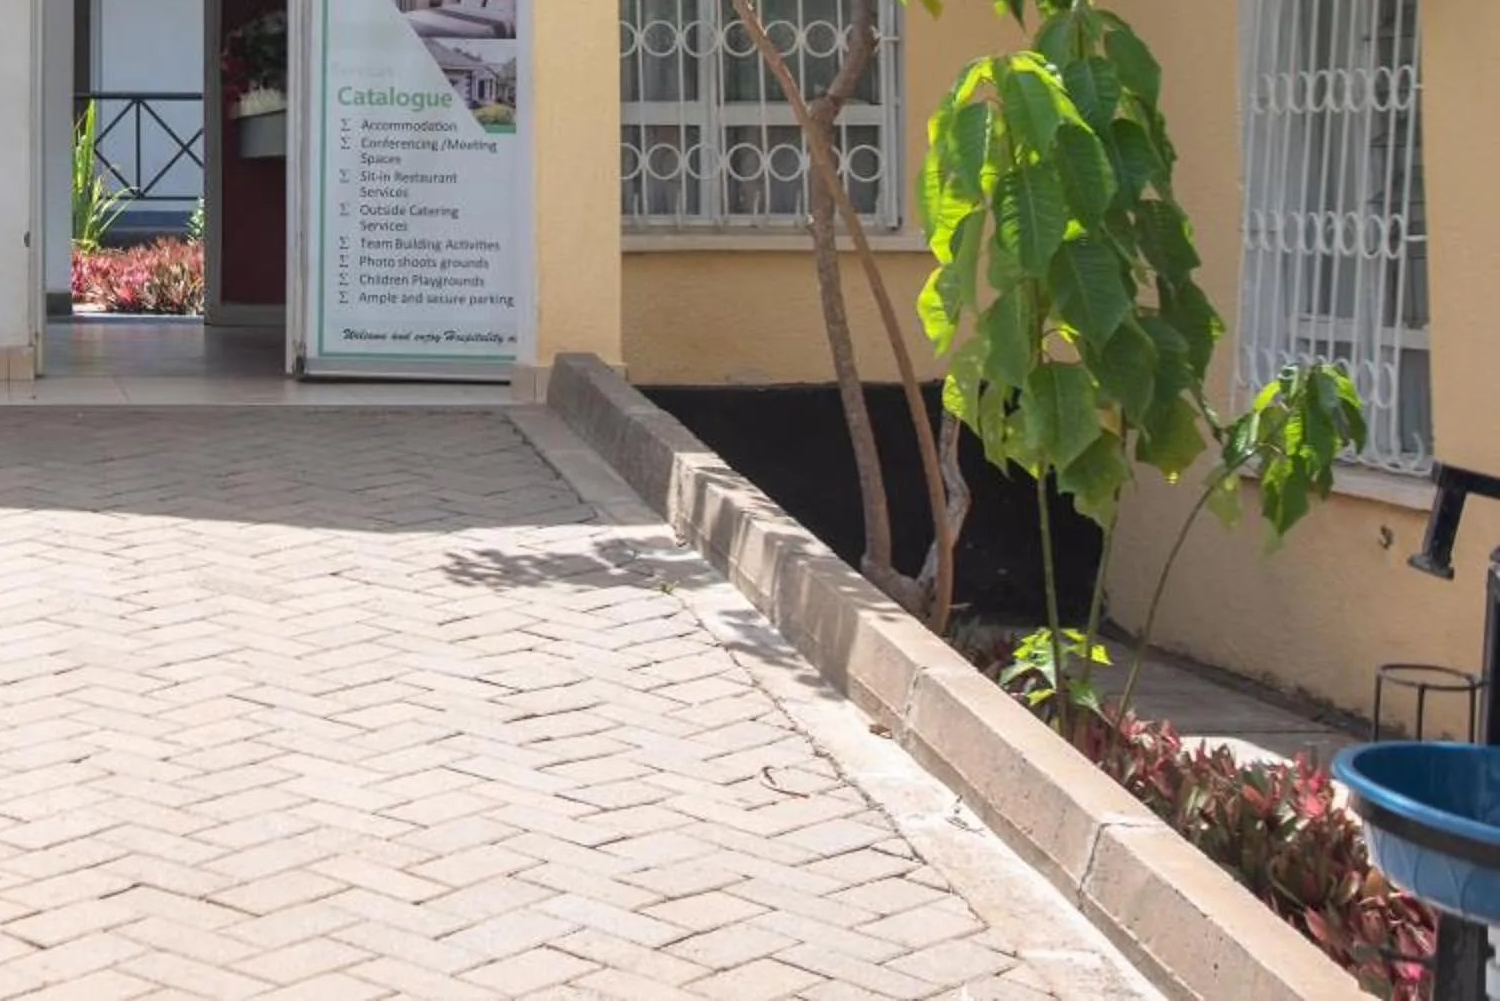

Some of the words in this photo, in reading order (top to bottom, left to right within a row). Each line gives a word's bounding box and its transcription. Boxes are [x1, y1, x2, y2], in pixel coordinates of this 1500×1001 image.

[337, 86, 453, 112] Catalogue
[361, 119, 458, 132] Accommodation
[361, 137, 438, 151] Conferencing
[360, 152, 401, 165] Spaces
[359, 170, 391, 183] Sit-in
[394, 171, 458, 184] Restaurant
[359, 186, 408, 198] Services
[359, 204, 406, 216] Outside
[409, 205, 459, 220] Catering
[359, 220, 408, 232] Services
[360, 237, 393, 250] Team
[395, 237, 441, 252] Building
[445, 238, 501, 251] Activities
[359, 255, 395, 268] Photo
[398, 255, 437, 268] shoots
[440, 256, 489, 270] grounds
[359, 274, 409, 286] Children
[411, 274, 485, 289] Playgrounds
[359, 292, 397, 305] Ample
[400, 291, 423, 304] and
[426, 294, 466, 305] secure
[469, 292, 515, 308] parking
